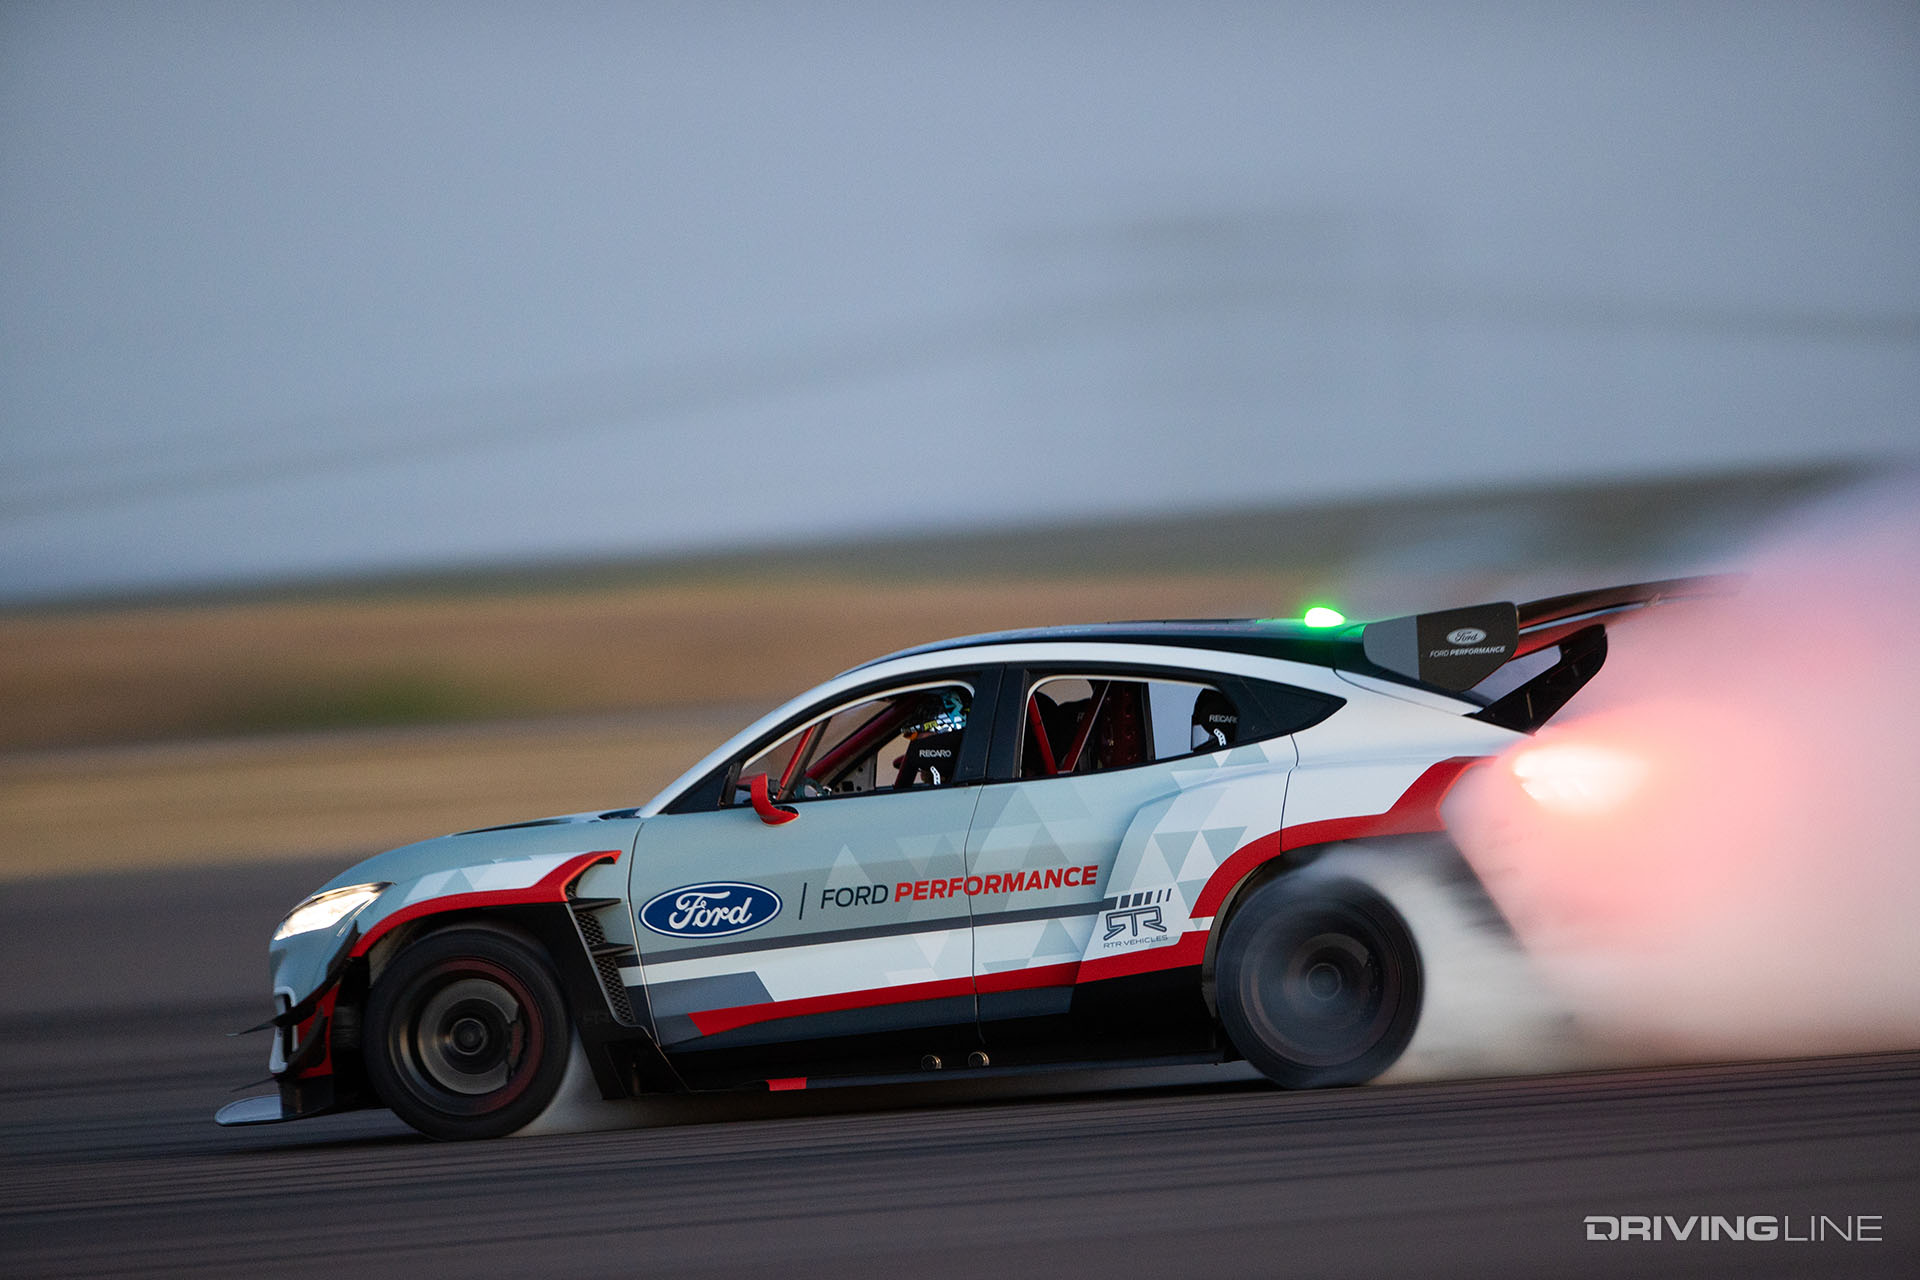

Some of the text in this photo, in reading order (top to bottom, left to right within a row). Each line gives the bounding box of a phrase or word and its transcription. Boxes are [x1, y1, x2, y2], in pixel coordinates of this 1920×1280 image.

[1454, 631, 1479, 642] Ford
[1429, 645, 1506, 658] FORD PERFORMANCE
[919, 749, 952, 758] RECARO
[821, 865, 1099, 909] FORD PERFORMANCE
[668, 891, 753, 930] Ford
[1103, 934, 1169, 949] RTR VEHICLES
